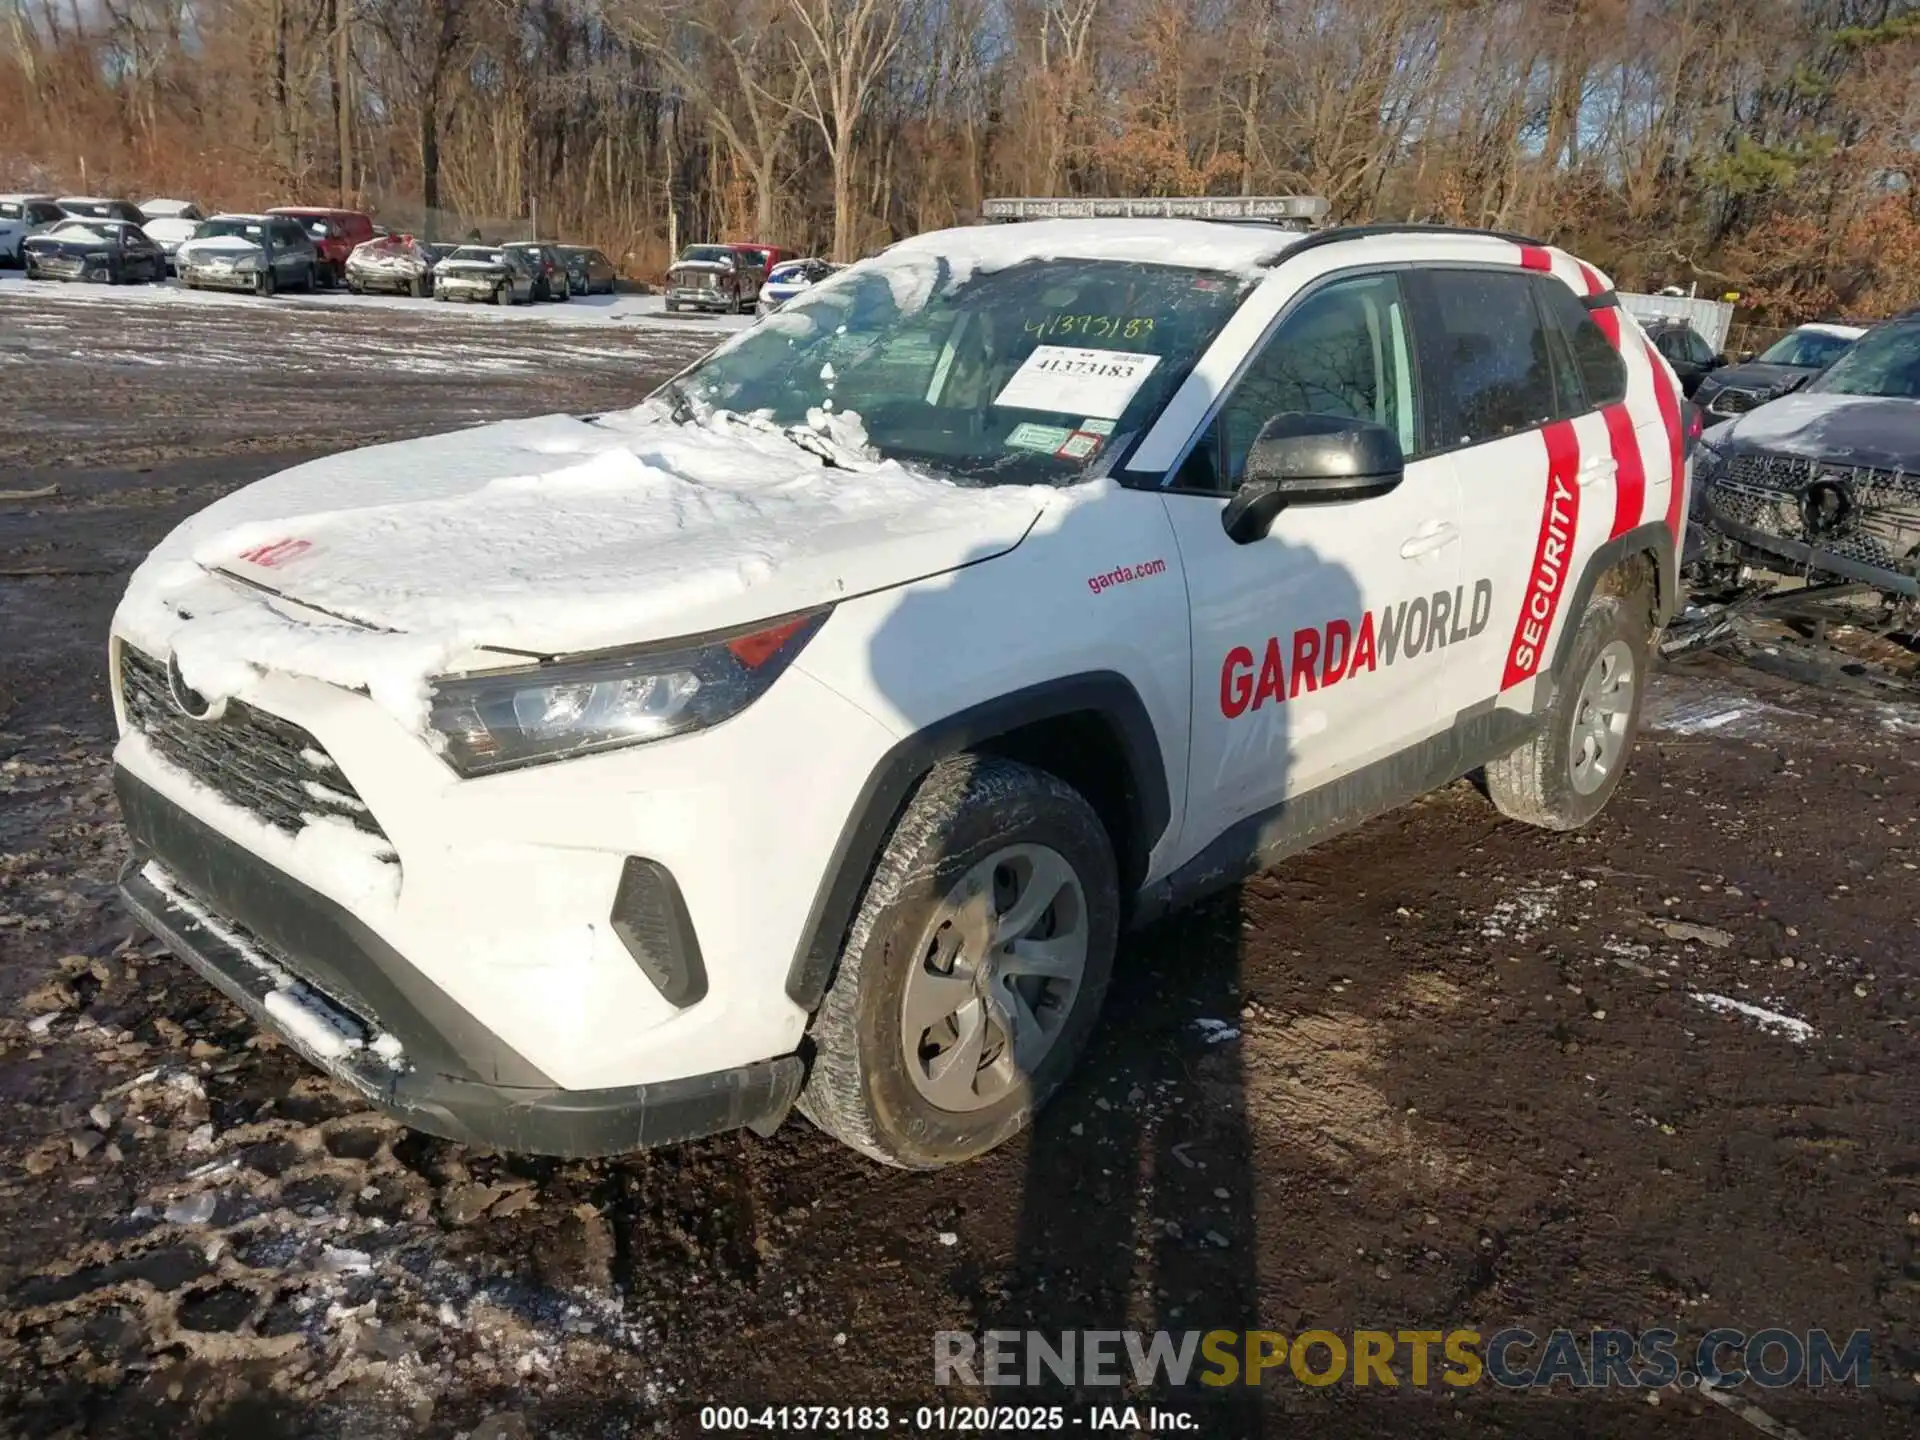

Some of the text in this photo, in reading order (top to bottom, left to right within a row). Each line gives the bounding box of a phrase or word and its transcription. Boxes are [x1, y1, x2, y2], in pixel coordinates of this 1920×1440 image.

[1024, 312, 1154, 338] 41373183
[1036, 359, 1134, 378] 41373183
[1088, 559, 1166, 594] garda.com
[1515, 475, 1572, 671] SECURITY
[1220, 578, 1492, 719] GARDAWORLD
